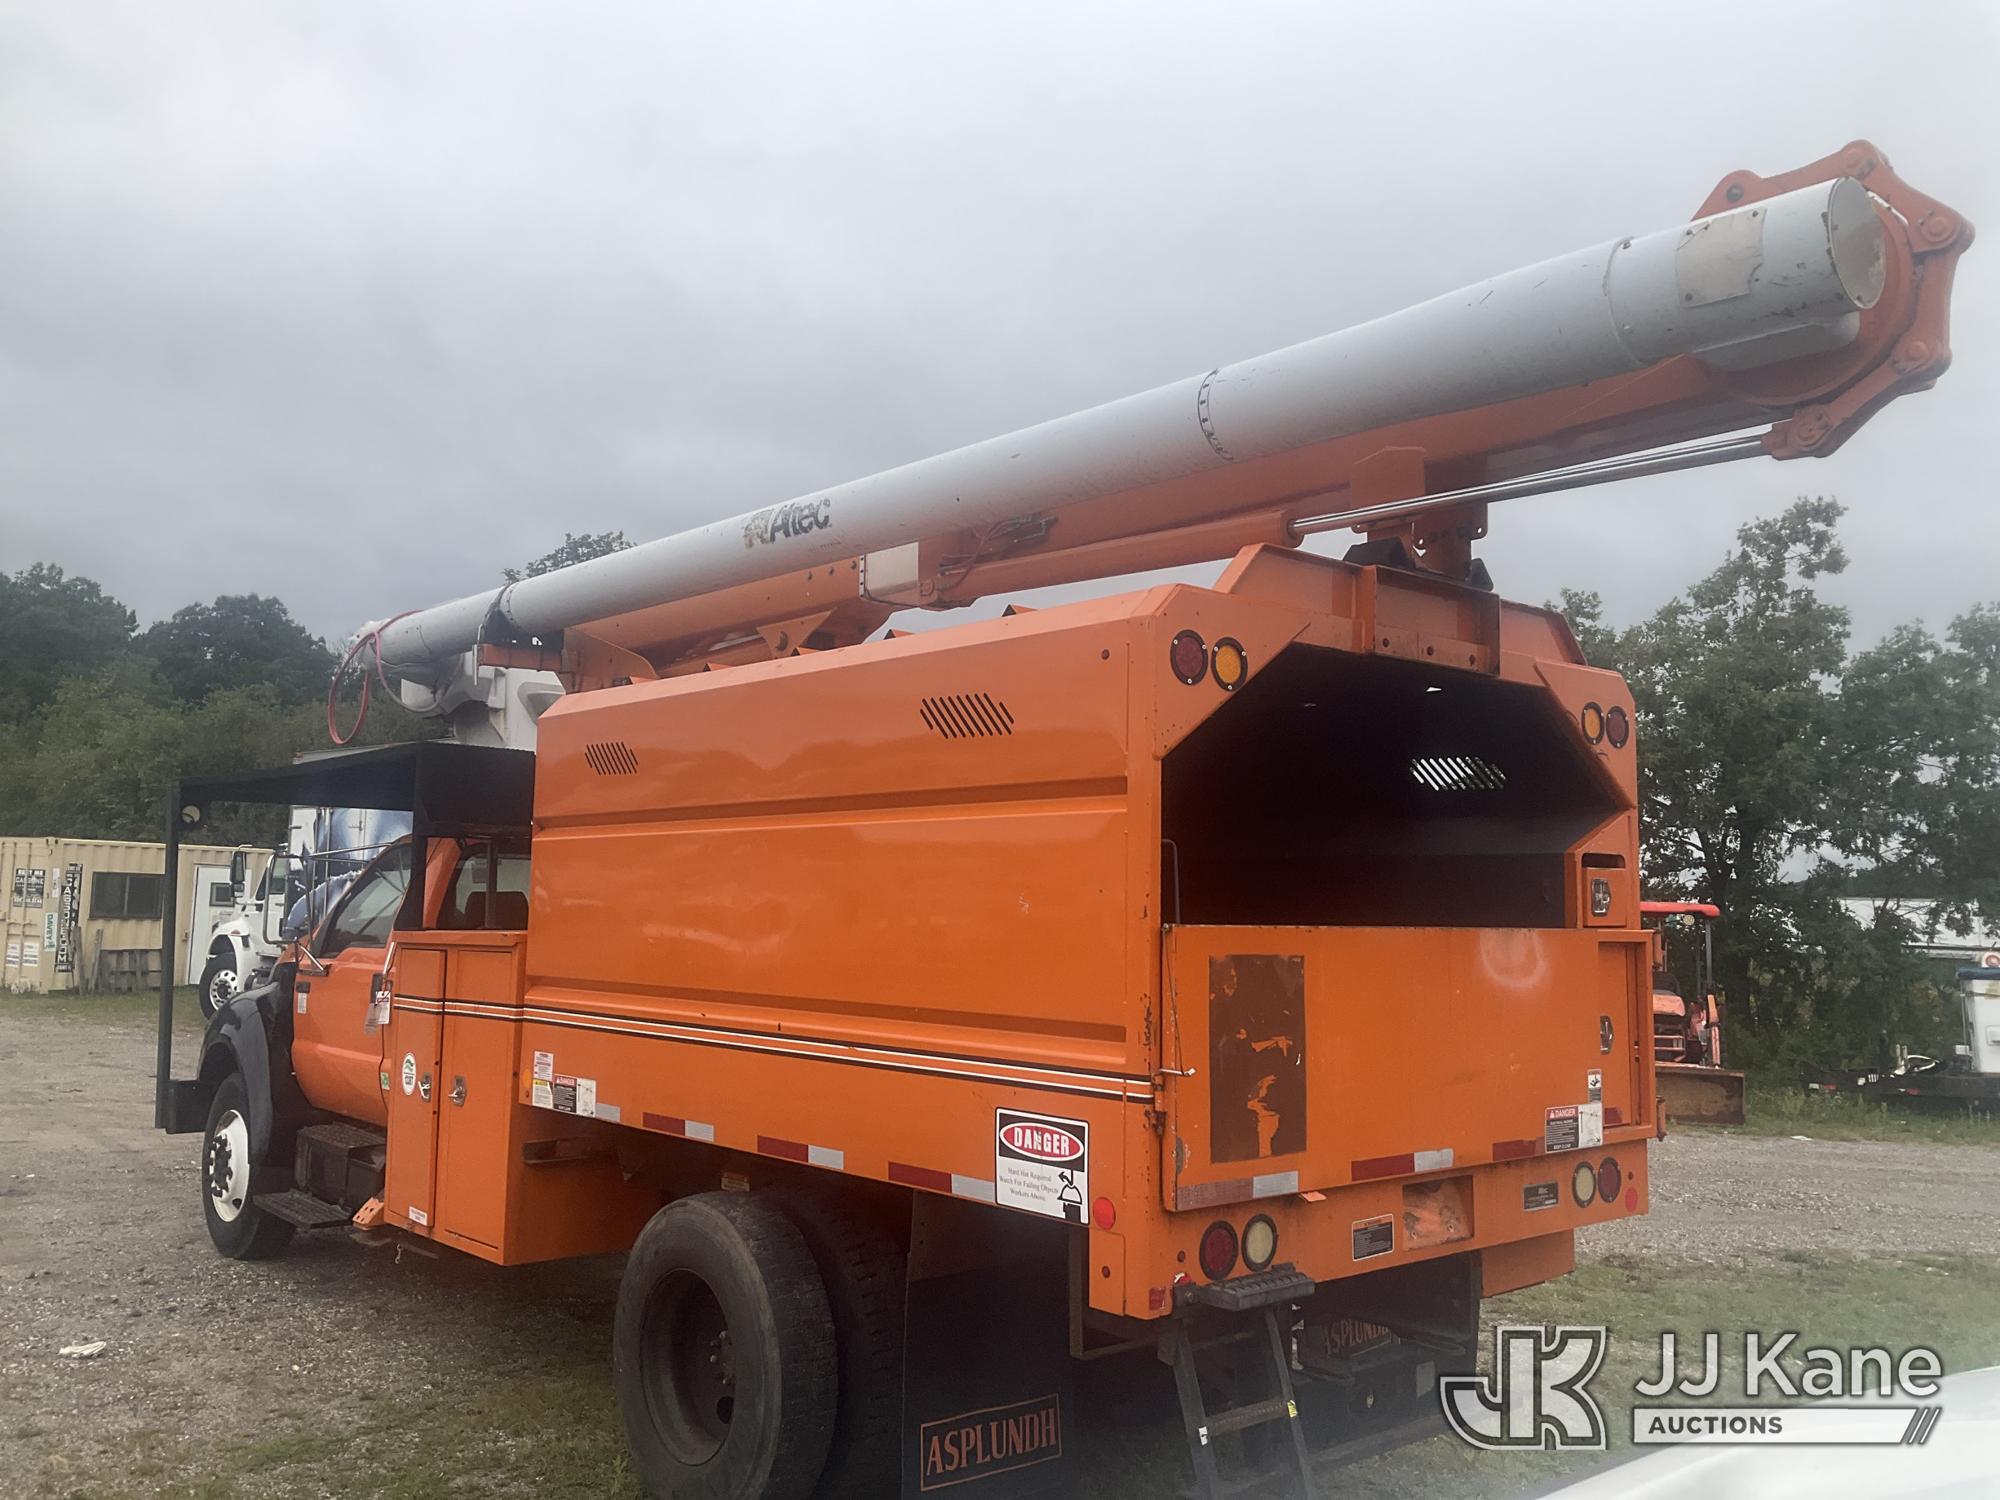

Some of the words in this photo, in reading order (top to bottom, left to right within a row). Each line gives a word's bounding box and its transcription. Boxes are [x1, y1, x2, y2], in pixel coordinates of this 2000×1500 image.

[46, 913, 54, 940] DAVEY
[1555, 1108, 1576, 1118] DANGER
[1014, 1127, 1070, 1156] DANGER
[1023, 1180, 1040, 1191] Falling
[926, 1408, 1057, 1476] ASPLUNDH
